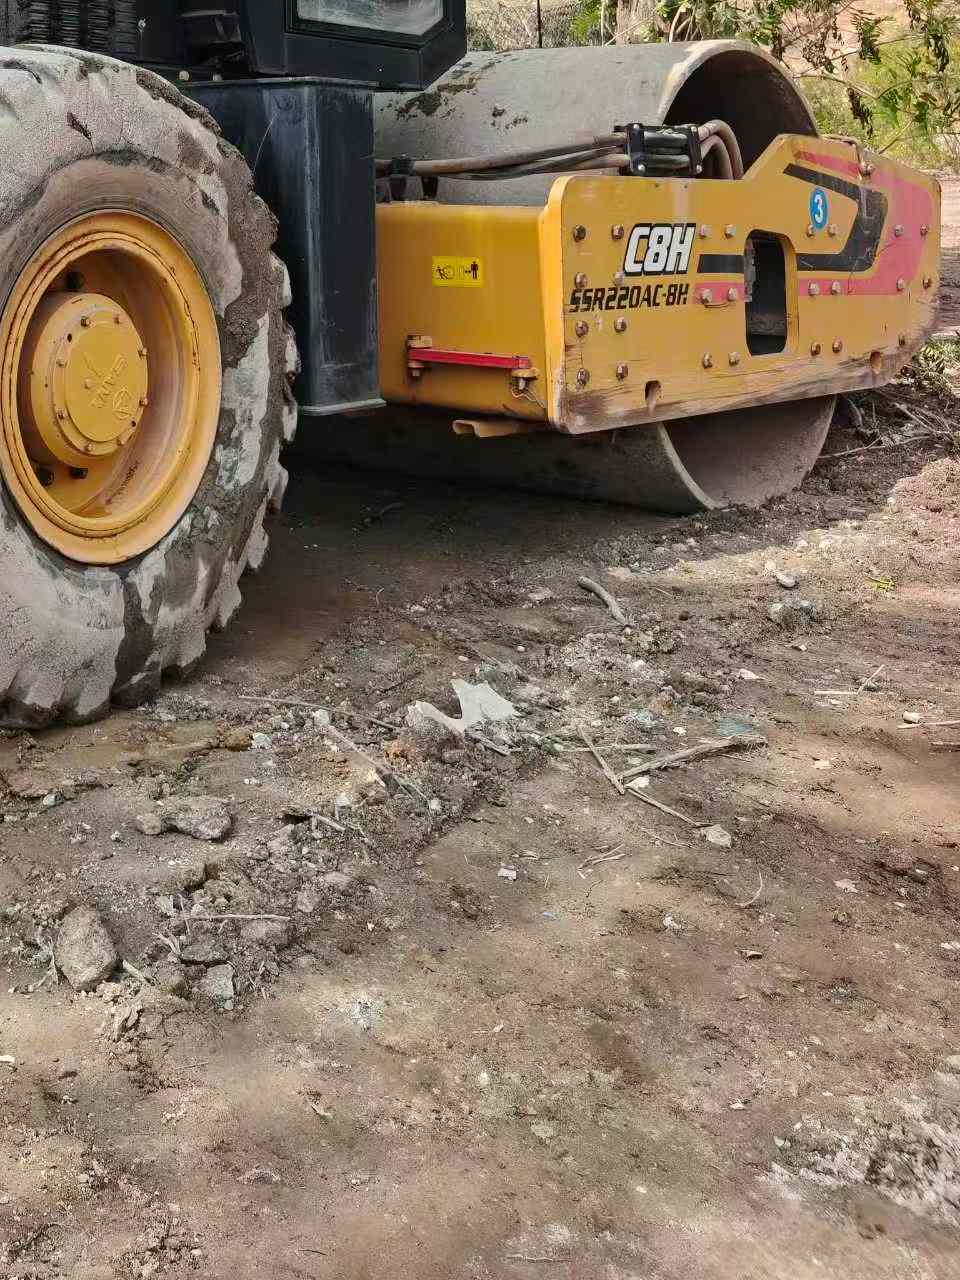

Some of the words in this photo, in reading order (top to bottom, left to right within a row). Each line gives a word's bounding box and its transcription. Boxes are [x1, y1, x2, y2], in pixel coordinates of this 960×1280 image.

[814, 194, 824, 223] 3
[624, 223, 696, 275] C8H
[569, 283, 689, 312] SSR220AC-8H
